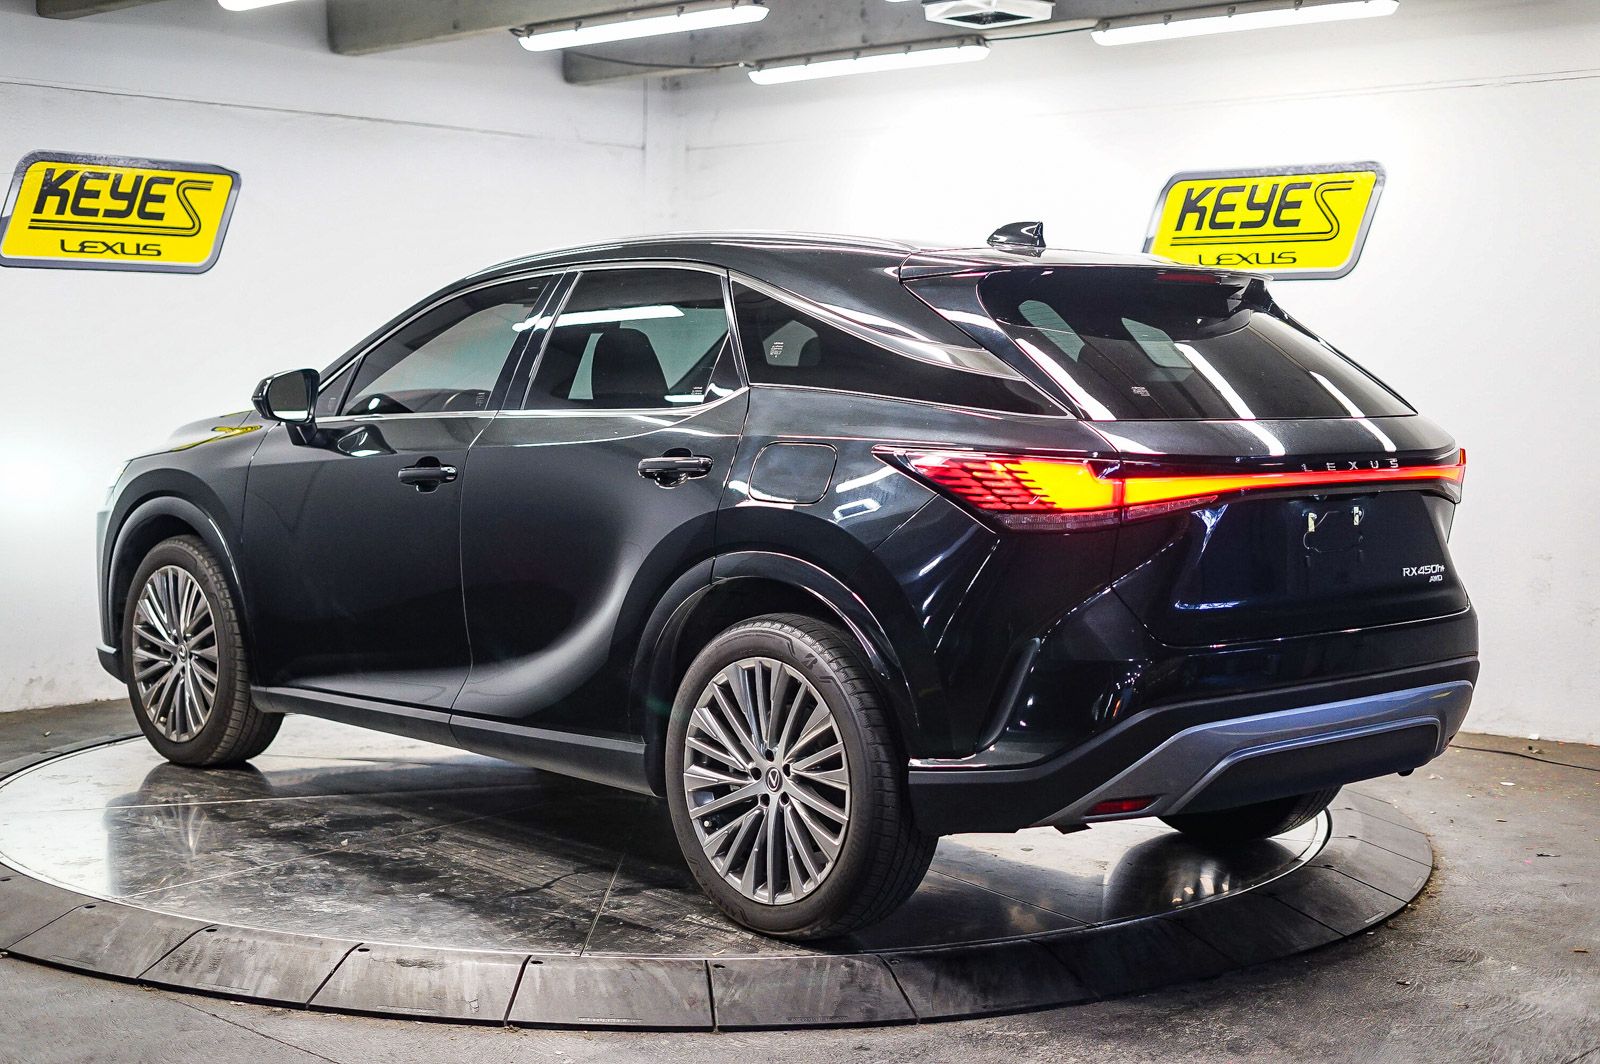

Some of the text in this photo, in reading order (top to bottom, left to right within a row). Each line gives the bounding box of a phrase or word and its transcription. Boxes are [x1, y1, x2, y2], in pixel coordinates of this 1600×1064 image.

[29, 168, 213, 236] KEYES
[1171, 180, 1354, 246] KEYES
[60, 239, 161, 257] LEXUS
[1198, 252, 1297, 266] LEXUS
[1301, 458, 1399, 472] LEXUS
